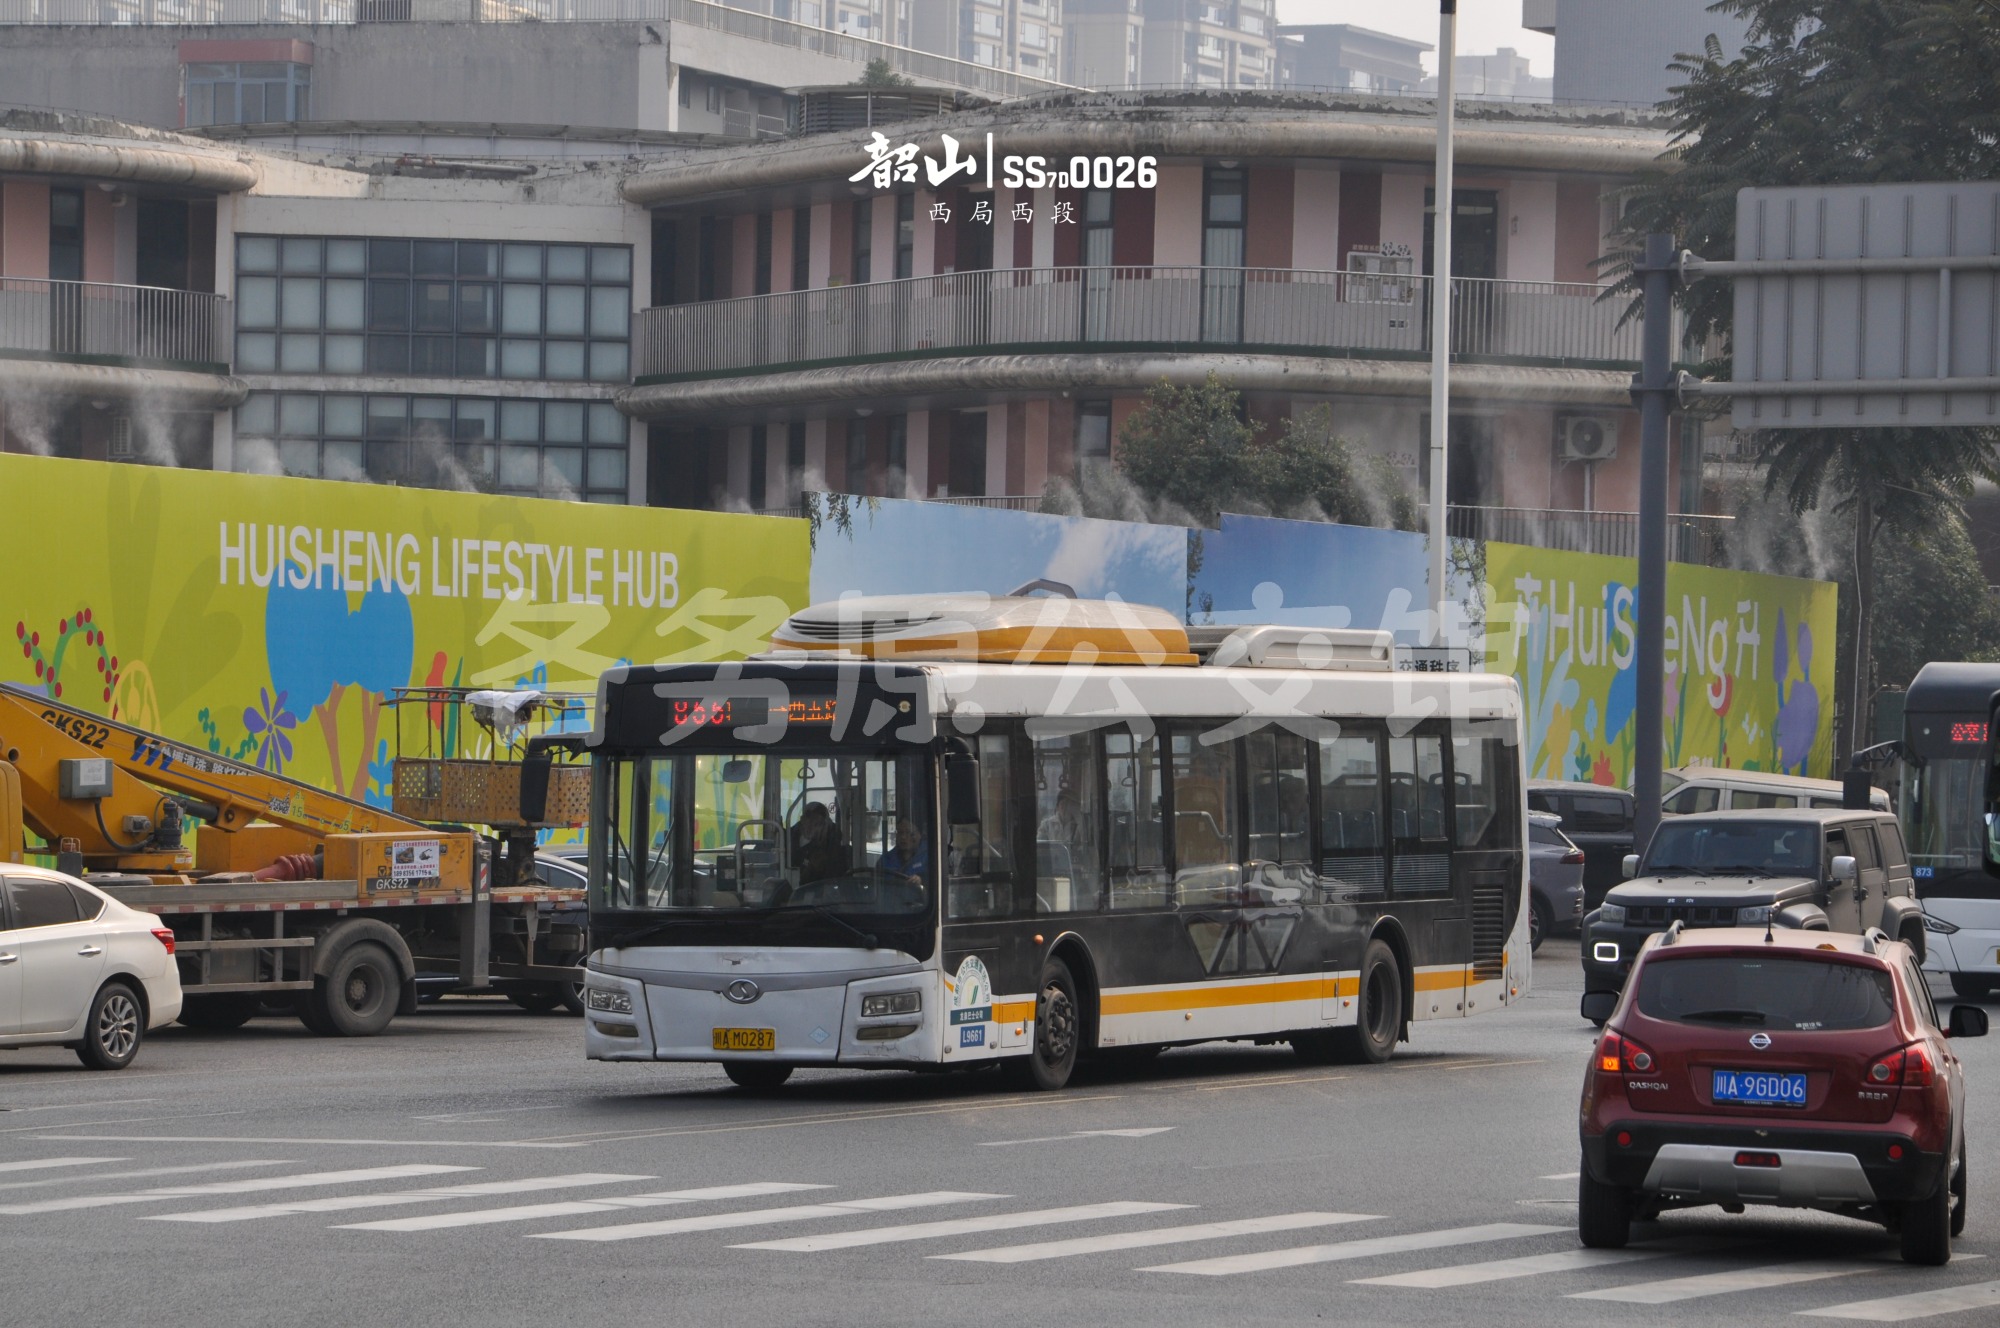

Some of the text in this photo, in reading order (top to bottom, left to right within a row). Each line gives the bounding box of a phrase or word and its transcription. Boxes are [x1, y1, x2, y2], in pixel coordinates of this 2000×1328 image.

[219, 521, 680, 608] HUISHENG LIFESTYLE HUB
[1549, 579, 1728, 709] HuiSeNg
[1951, 721, 1989, 742] 公交
[1915, 867, 1932, 877] 873
[376, 877, 409, 890] GKS22
[962, 1029, 982, 1043] L9661
[1629, 1081, 1669, 1091] QASHQAI
